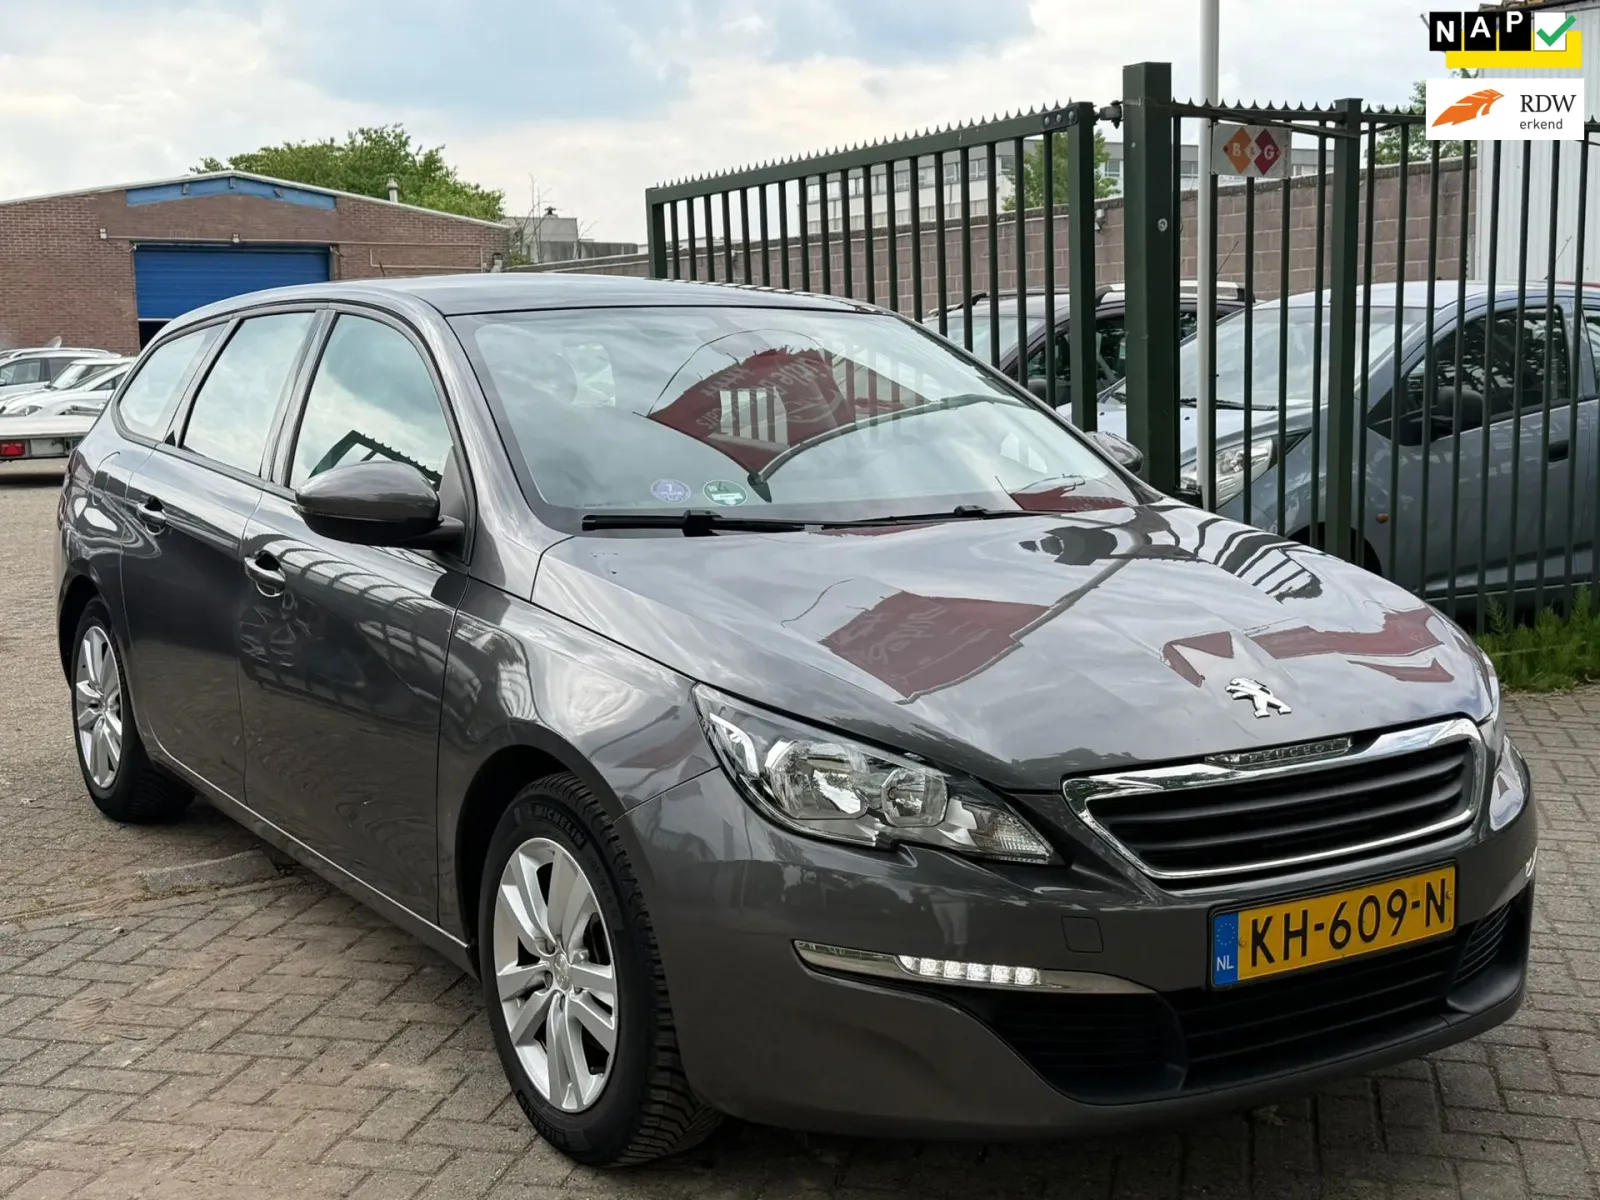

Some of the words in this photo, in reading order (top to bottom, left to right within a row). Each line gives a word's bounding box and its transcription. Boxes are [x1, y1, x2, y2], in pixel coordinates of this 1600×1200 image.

[534, 804, 584, 846] MICHELIN
[1251, 878, 1446, 967] KH-609-N
[1216, 956, 1234, 971] NL
